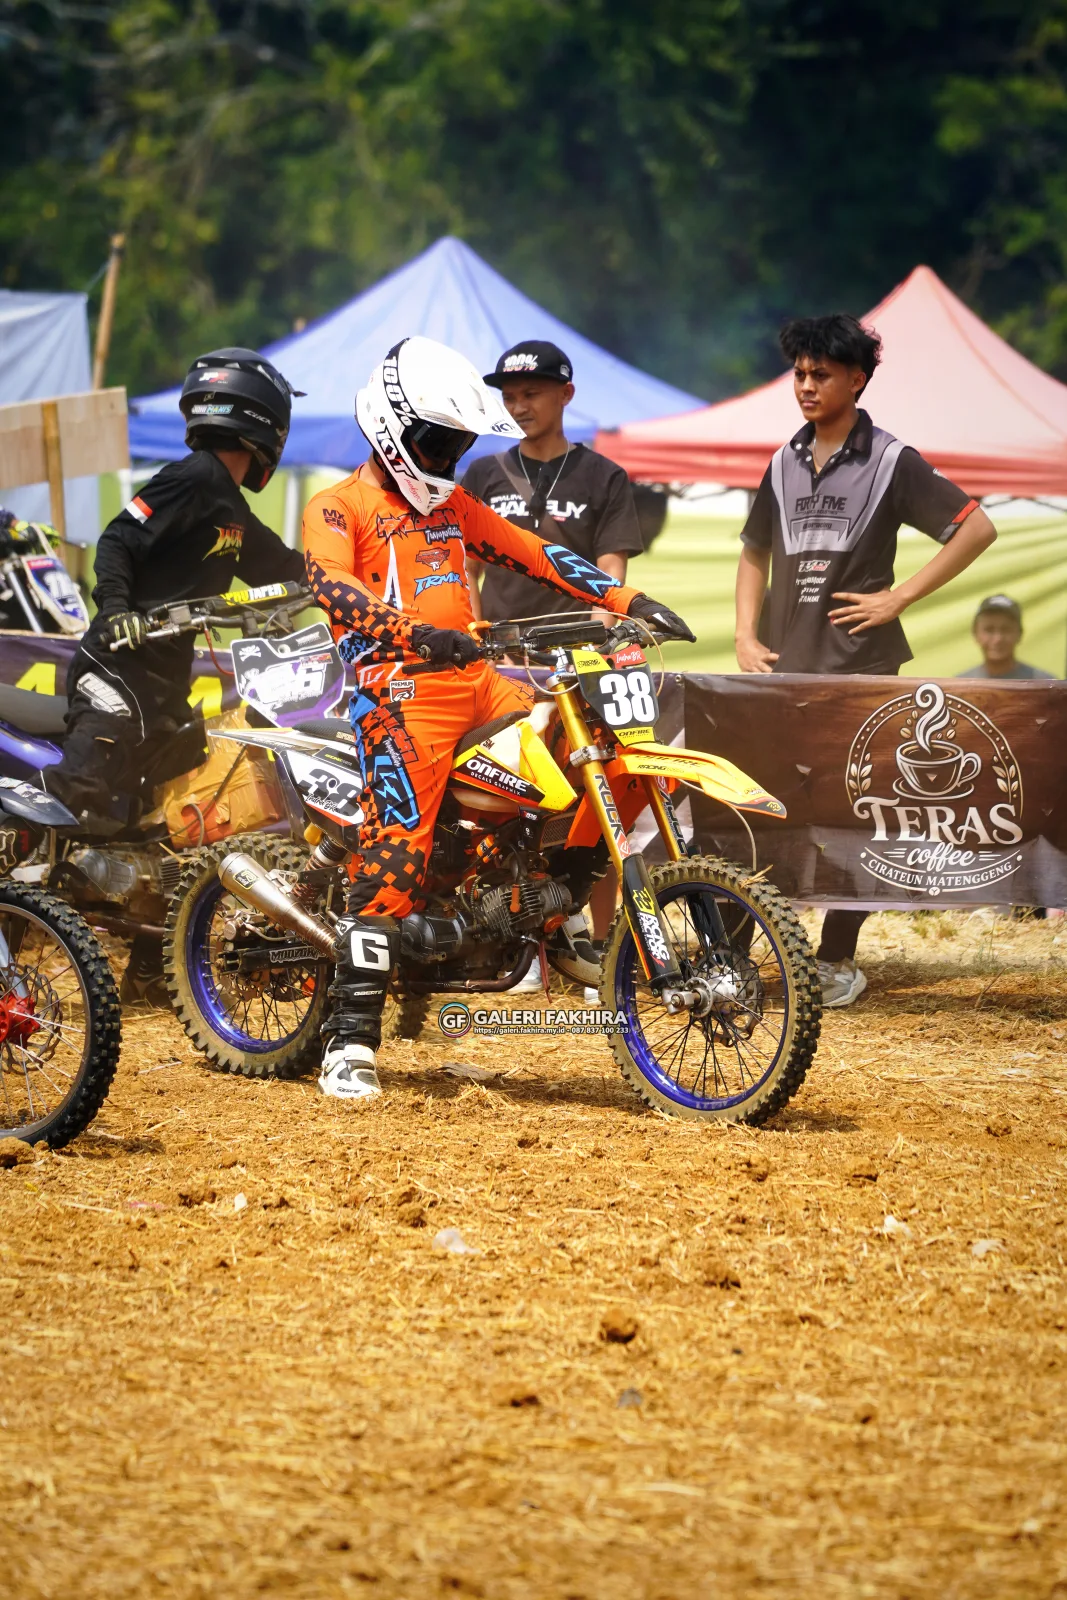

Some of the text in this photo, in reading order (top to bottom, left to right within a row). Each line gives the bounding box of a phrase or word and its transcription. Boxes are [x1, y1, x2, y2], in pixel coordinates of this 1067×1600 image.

[383, 356, 419, 427] 100%
[376, 424, 419, 481] KYT
[795, 494, 848, 512] FORTY FIVE
[600, 671, 655, 726] 38
[300, 769, 362, 817] 38
[470, 771, 492, 784] DECALS
[853, 796, 1023, 845] TERAS
[868, 859, 1013, 886] CIRATEUN MATENGGENG
[906, 842, 976, 872] coffee
[350, 930, 390, 972] G
